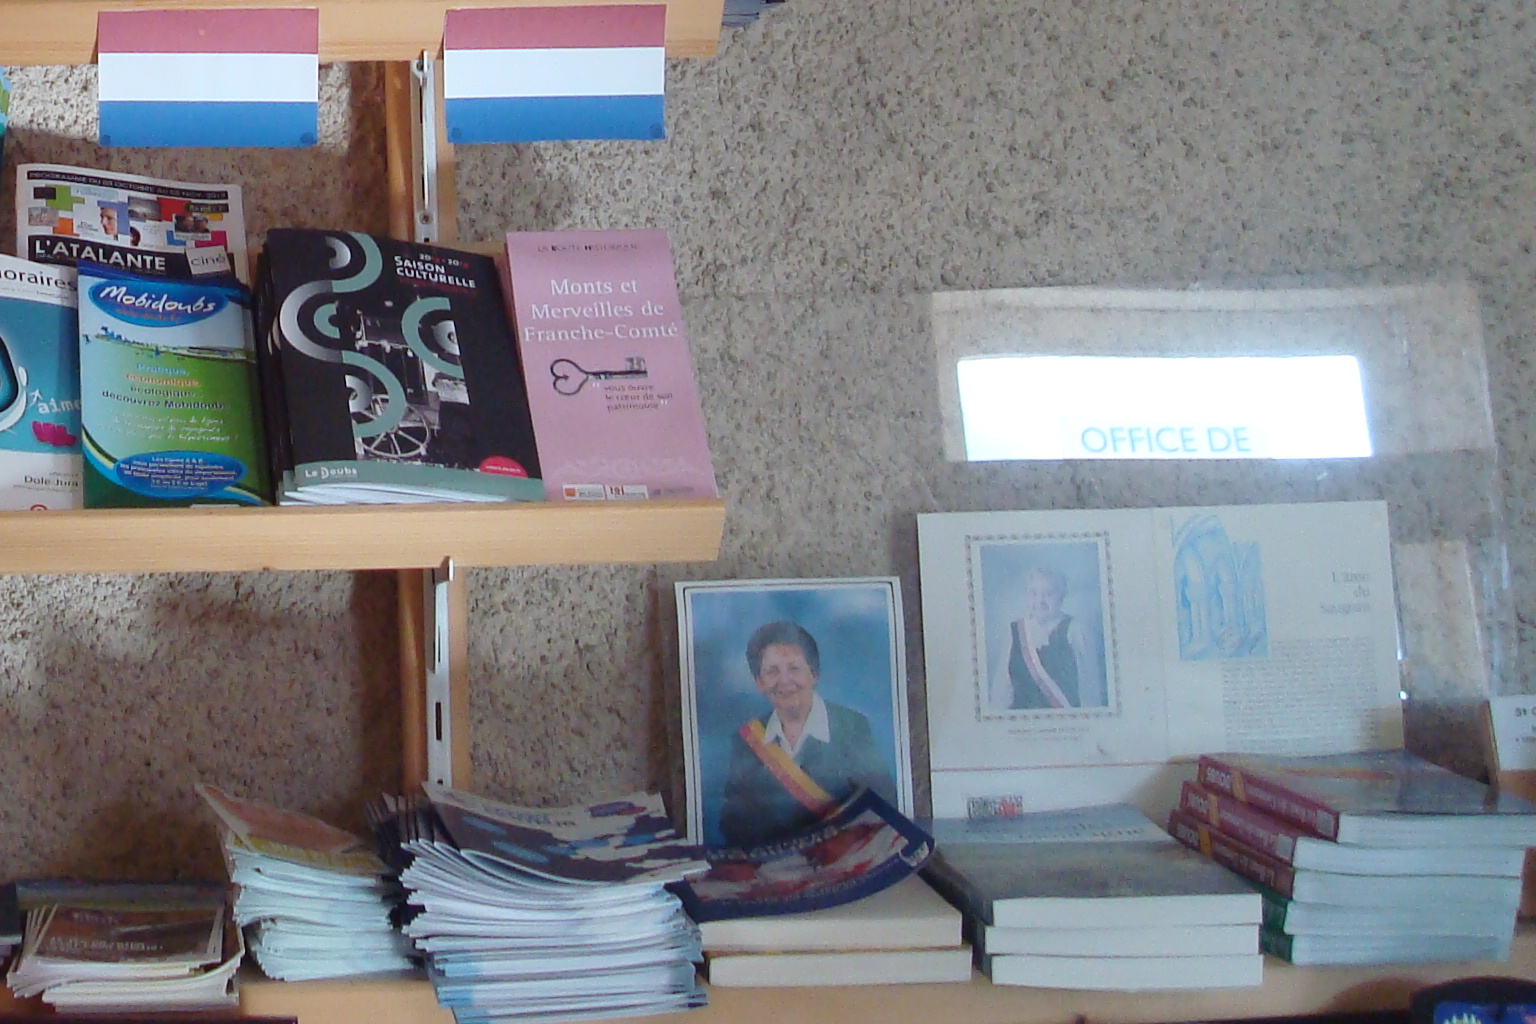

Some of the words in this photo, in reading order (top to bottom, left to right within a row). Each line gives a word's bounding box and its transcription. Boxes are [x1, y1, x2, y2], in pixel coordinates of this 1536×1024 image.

[35, 239, 166, 271] L'ATALANTE
[190, 251, 226, 268] ciné
[394, 255, 445, 274] SAISON
[396, 267, 477, 289] CULTURELLE
[550, 278, 613, 296] Monts
[620, 278, 638, 294] et
[100, 284, 217, 314] Mobidoubs
[531, 300, 634, 320] Merveilles
[641, 300, 664, 316] de
[524, 322, 679, 342] Franche-Comté
[1081, 426, 1198, 454] OFFICE
[1207, 426, 1252, 453] DE
[24, 475, 51, 486] Dole
[304, 469, 318, 478] Le
[320, 466, 358, 479] Doubs
